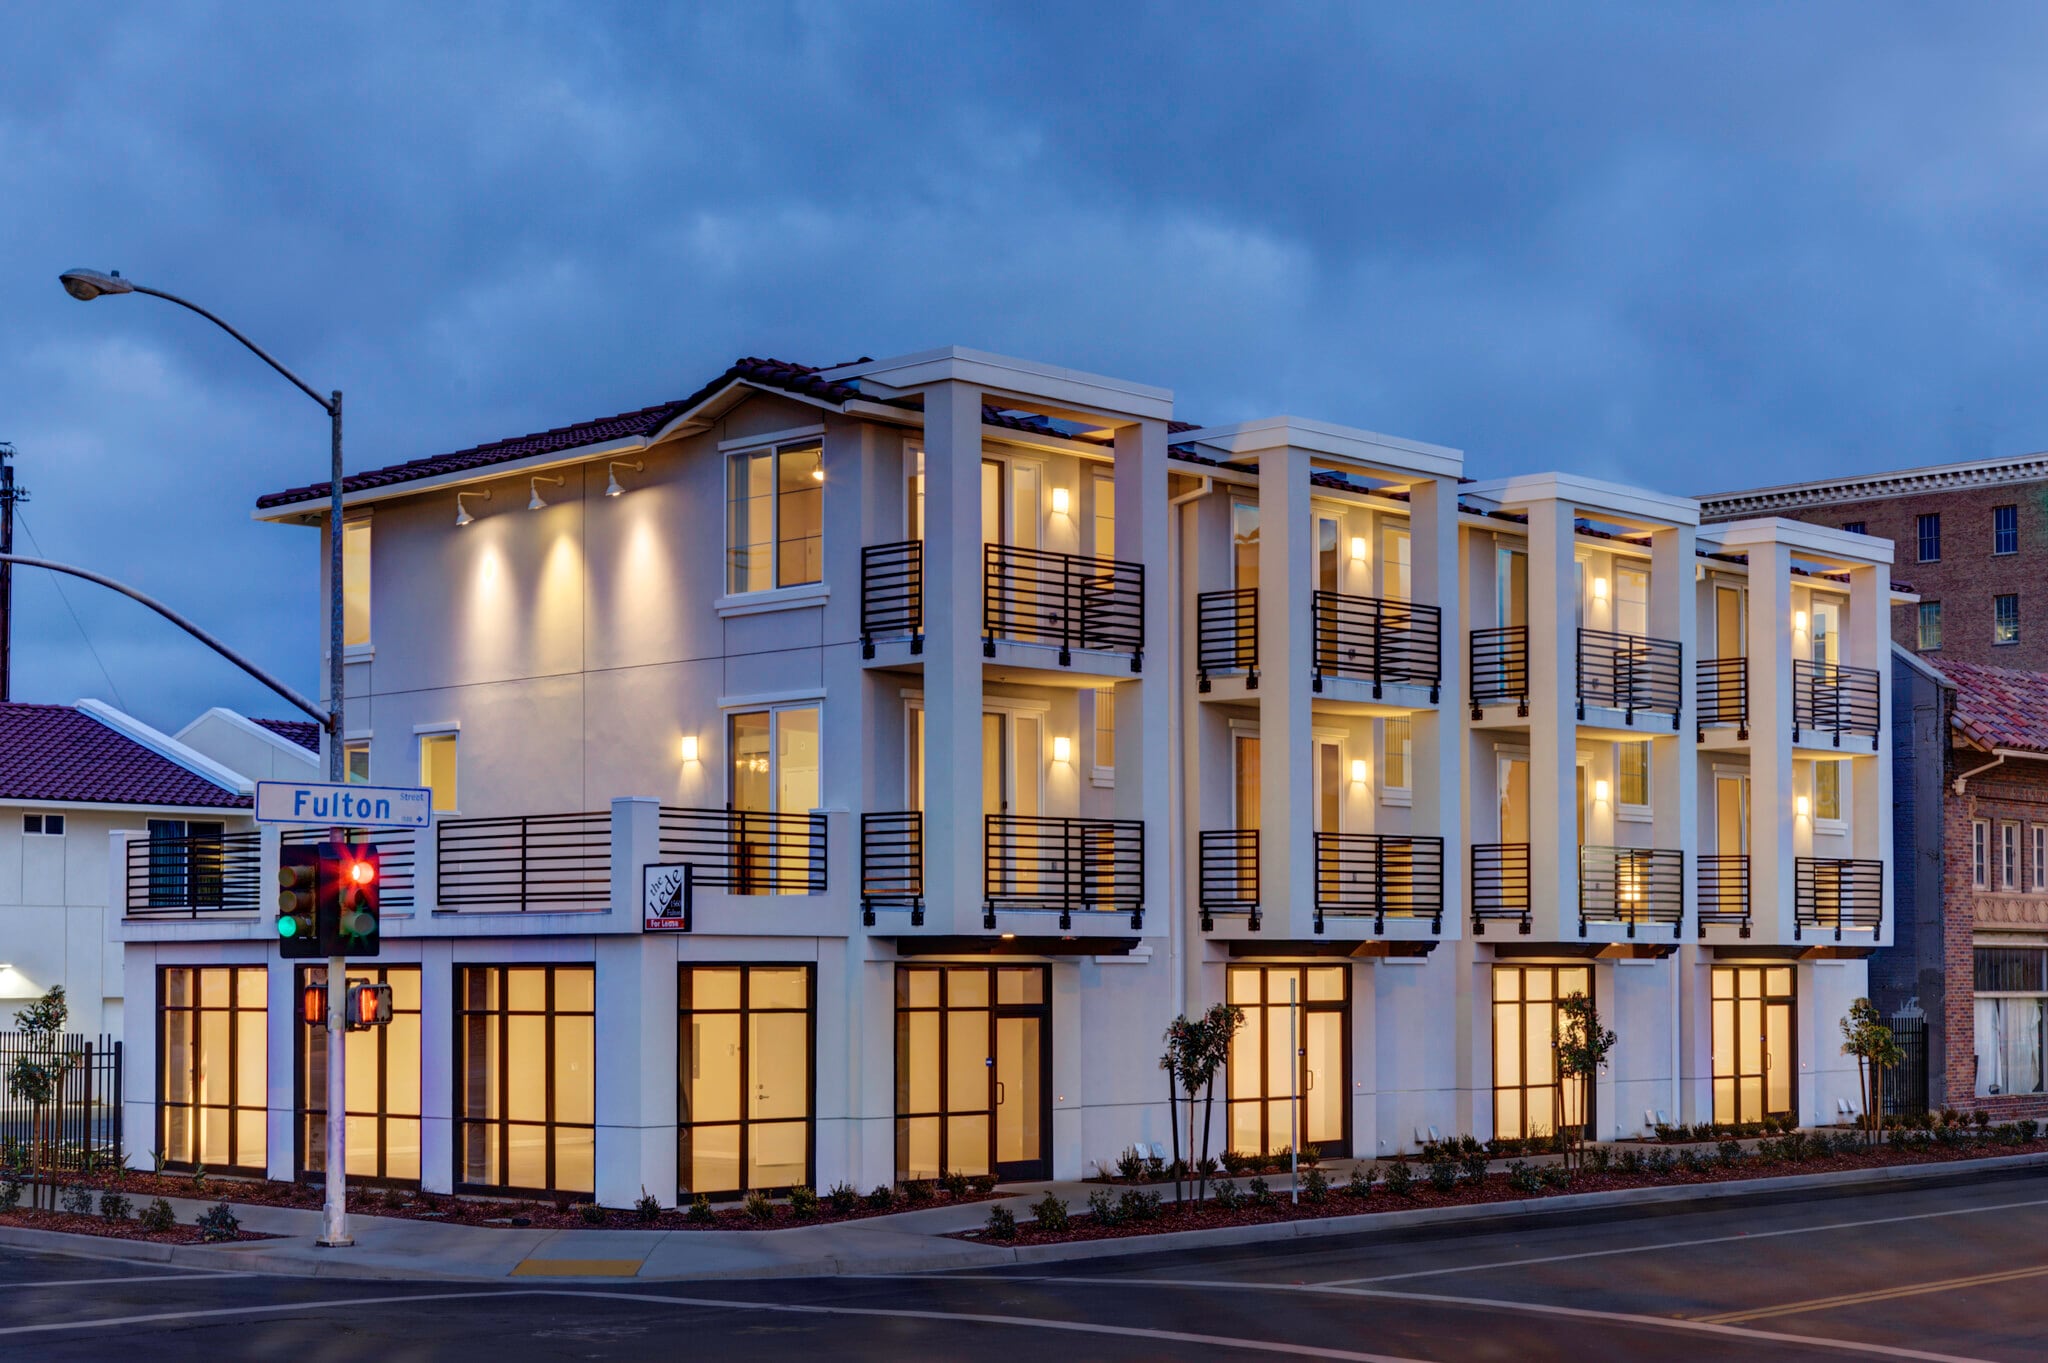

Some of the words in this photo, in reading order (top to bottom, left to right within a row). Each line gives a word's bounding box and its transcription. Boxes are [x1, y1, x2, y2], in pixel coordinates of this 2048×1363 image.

[294, 790, 390, 819] Fulton
[399, 792, 424, 801] Street
[649, 869, 681, 916] Lede
[650, 877, 663, 896] the
[651, 919, 660, 928] For
